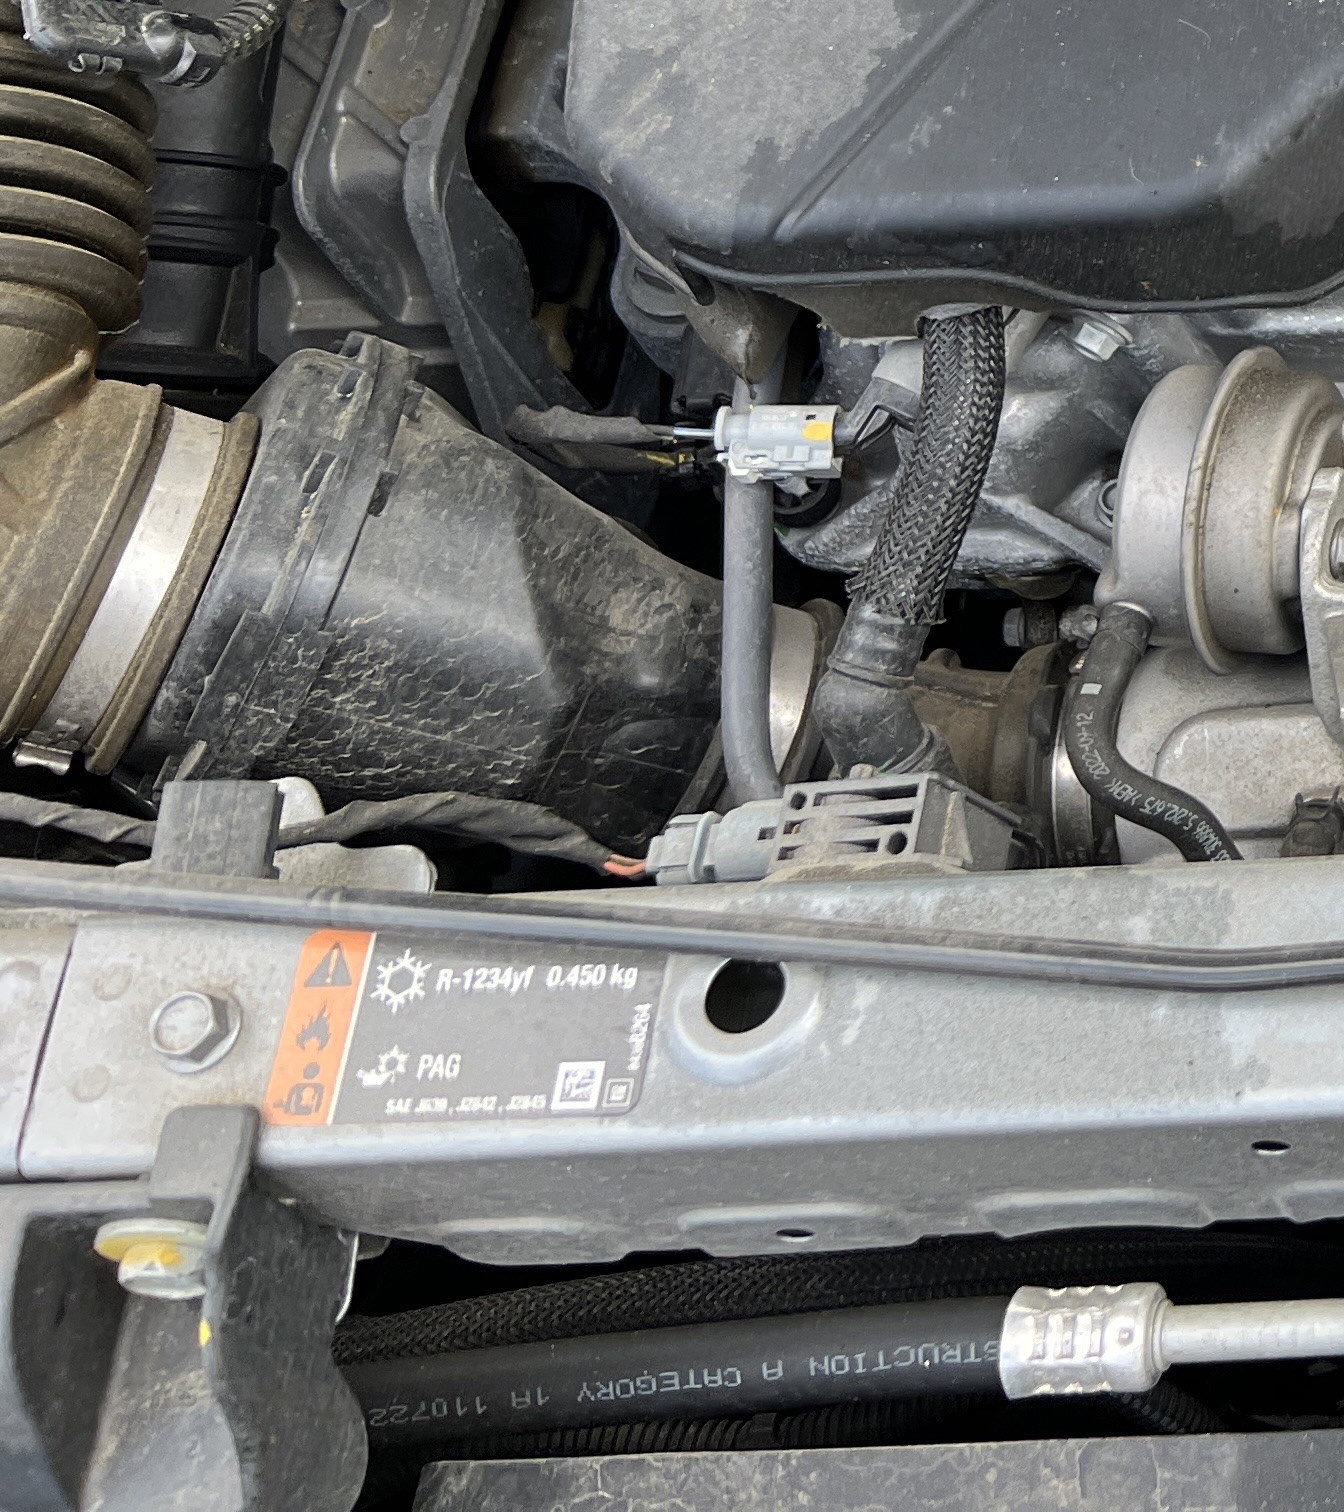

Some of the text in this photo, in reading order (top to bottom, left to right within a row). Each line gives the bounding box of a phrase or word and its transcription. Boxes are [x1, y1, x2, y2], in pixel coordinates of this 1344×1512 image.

[436, 962, 639, 998] R-1234yf 0.450 kg
[416, 1052, 462, 1082] PAG
[577, 1365, 742, 1402] CATEGORY
[761, 1359, 784, 1381] A
[368, 1395, 488, 1428] 110722
[511, 1386, 550, 1410] 1A
